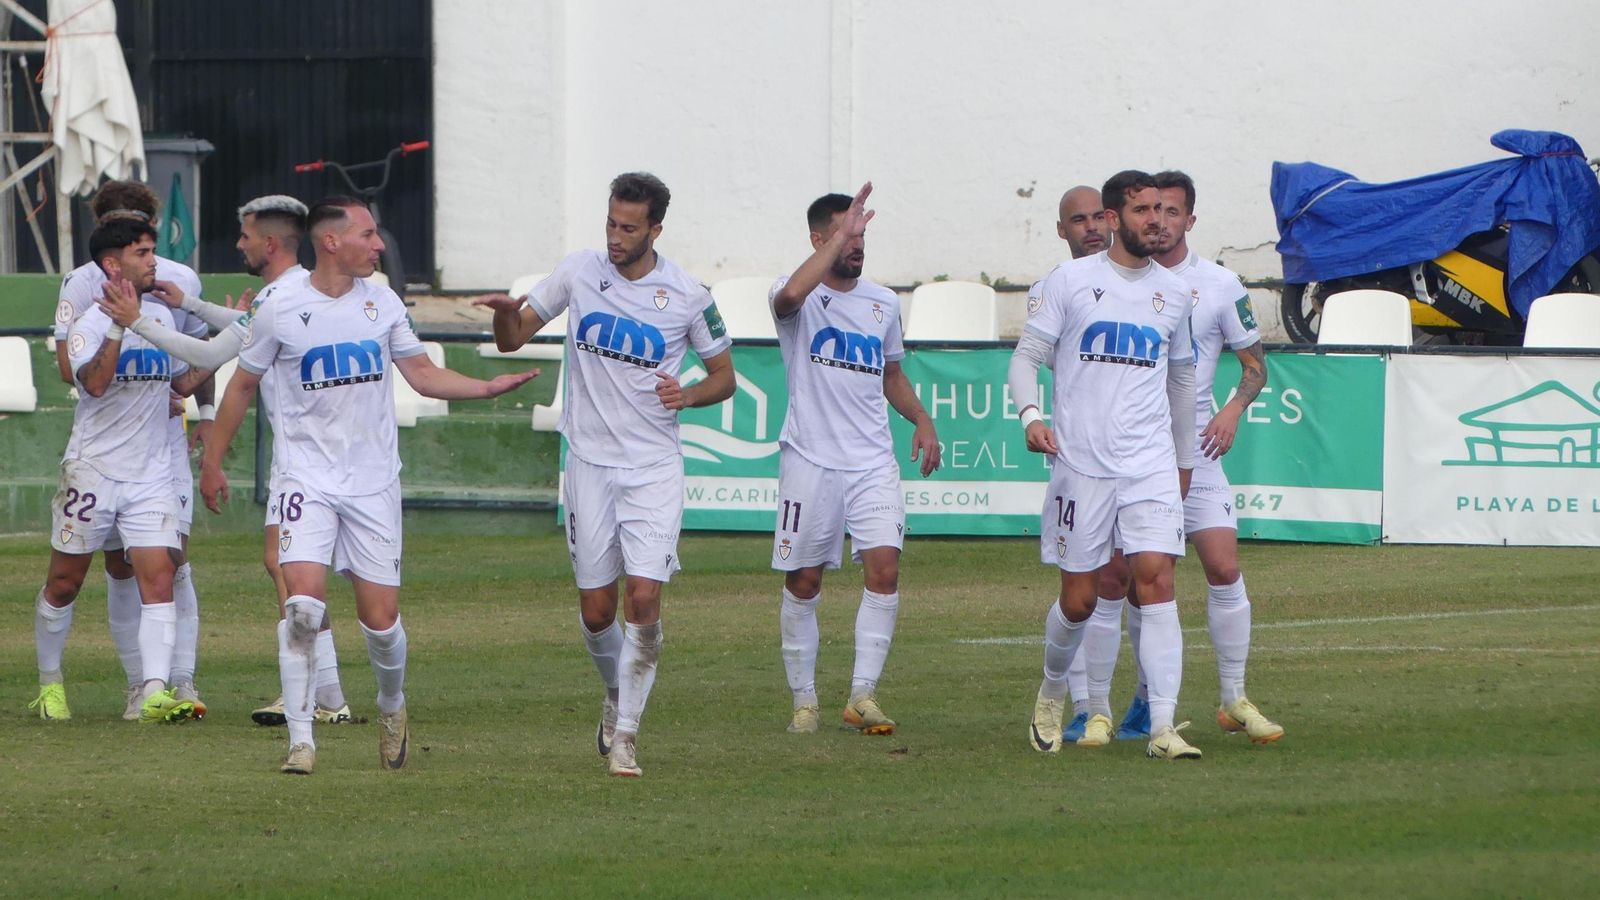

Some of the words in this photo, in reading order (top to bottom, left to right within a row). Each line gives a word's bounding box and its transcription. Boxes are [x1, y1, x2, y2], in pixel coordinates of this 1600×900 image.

[1443, 278, 1485, 314] MBK
[577, 342, 658, 368] AMSYSTEM
[63, 487, 97, 523] 22
[279, 491, 305, 524] 18
[782, 499, 802, 533] 11
[1055, 495, 1076, 532] 14
[1235, 492, 1283, 511] 847
[1456, 496, 1535, 513] PLAYA
[1547, 498, 1579, 513] DE
[569, 511, 576, 545] 6
